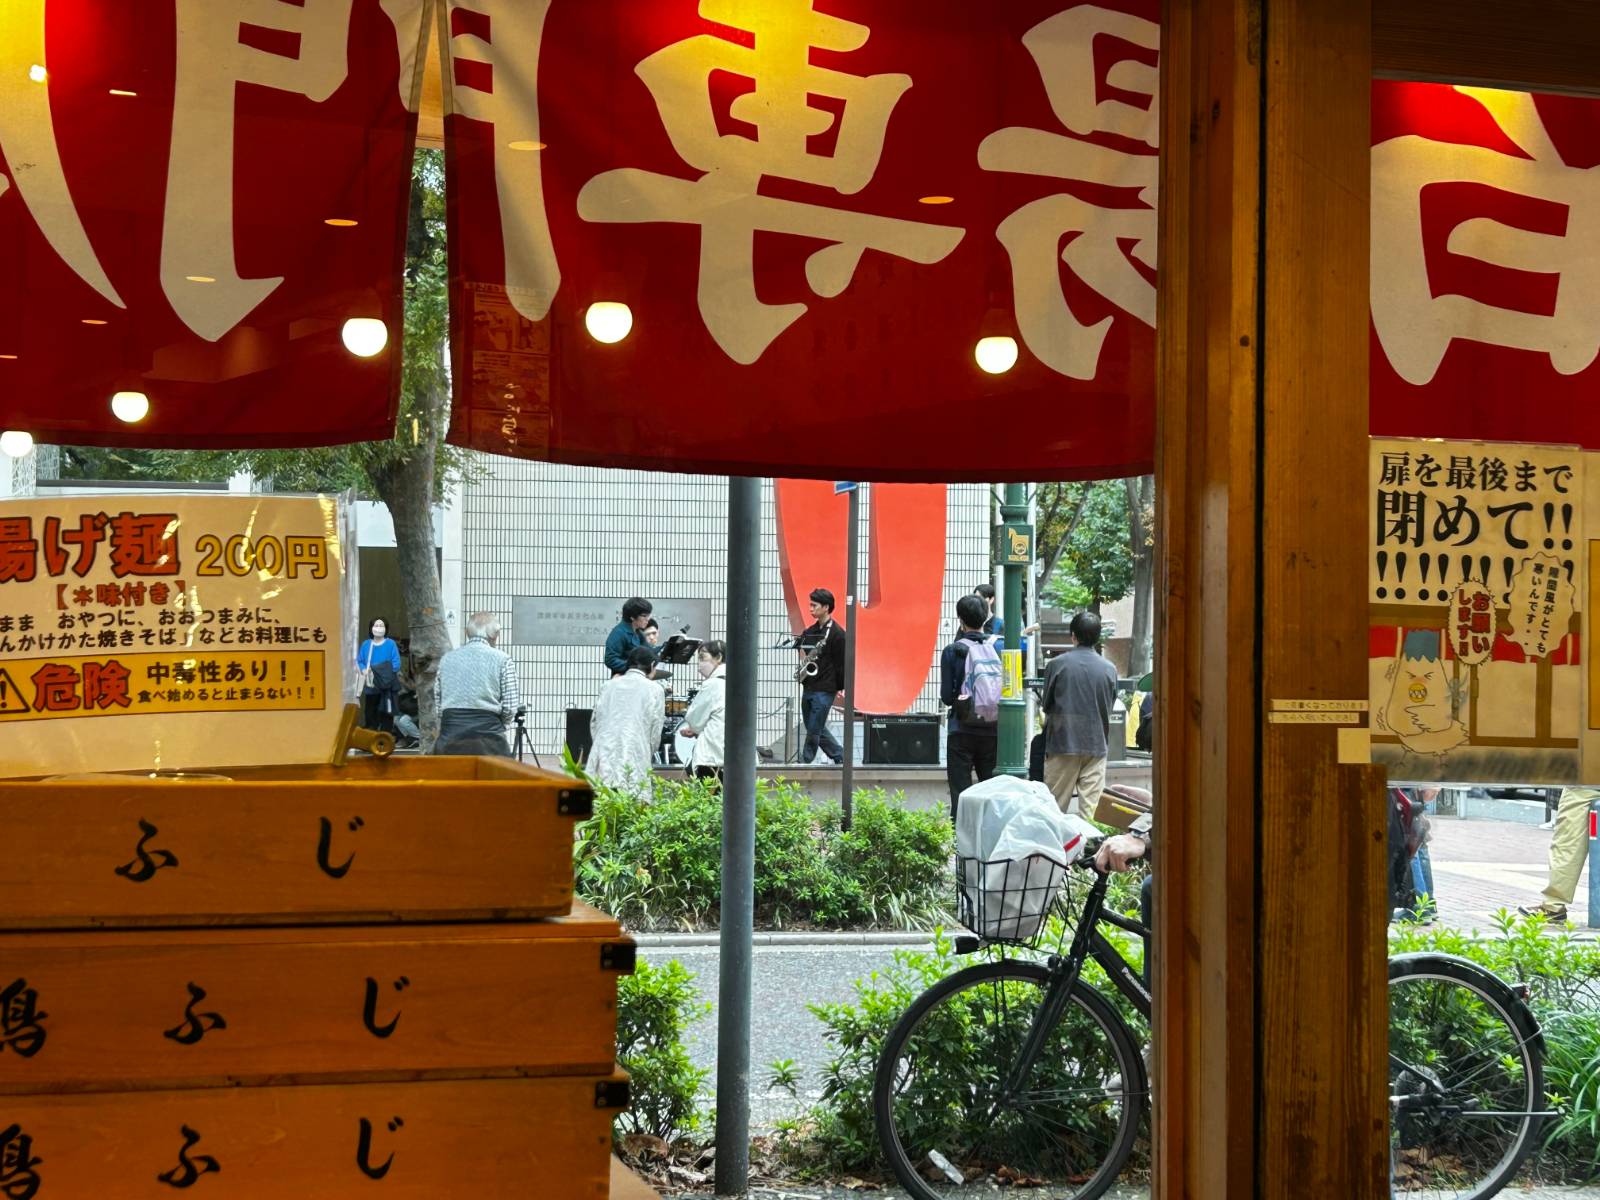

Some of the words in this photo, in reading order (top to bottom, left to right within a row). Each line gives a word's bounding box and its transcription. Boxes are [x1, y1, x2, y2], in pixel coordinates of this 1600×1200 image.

[1379, 452, 1574, 494] 扉を最後まで
[1377, 489, 1573, 550] 閉めて!!
[196, 534, 328, 579] 200円
[31, 660, 133, 713] 危険
[147, 660, 310, 685] 中毒性あり!!
